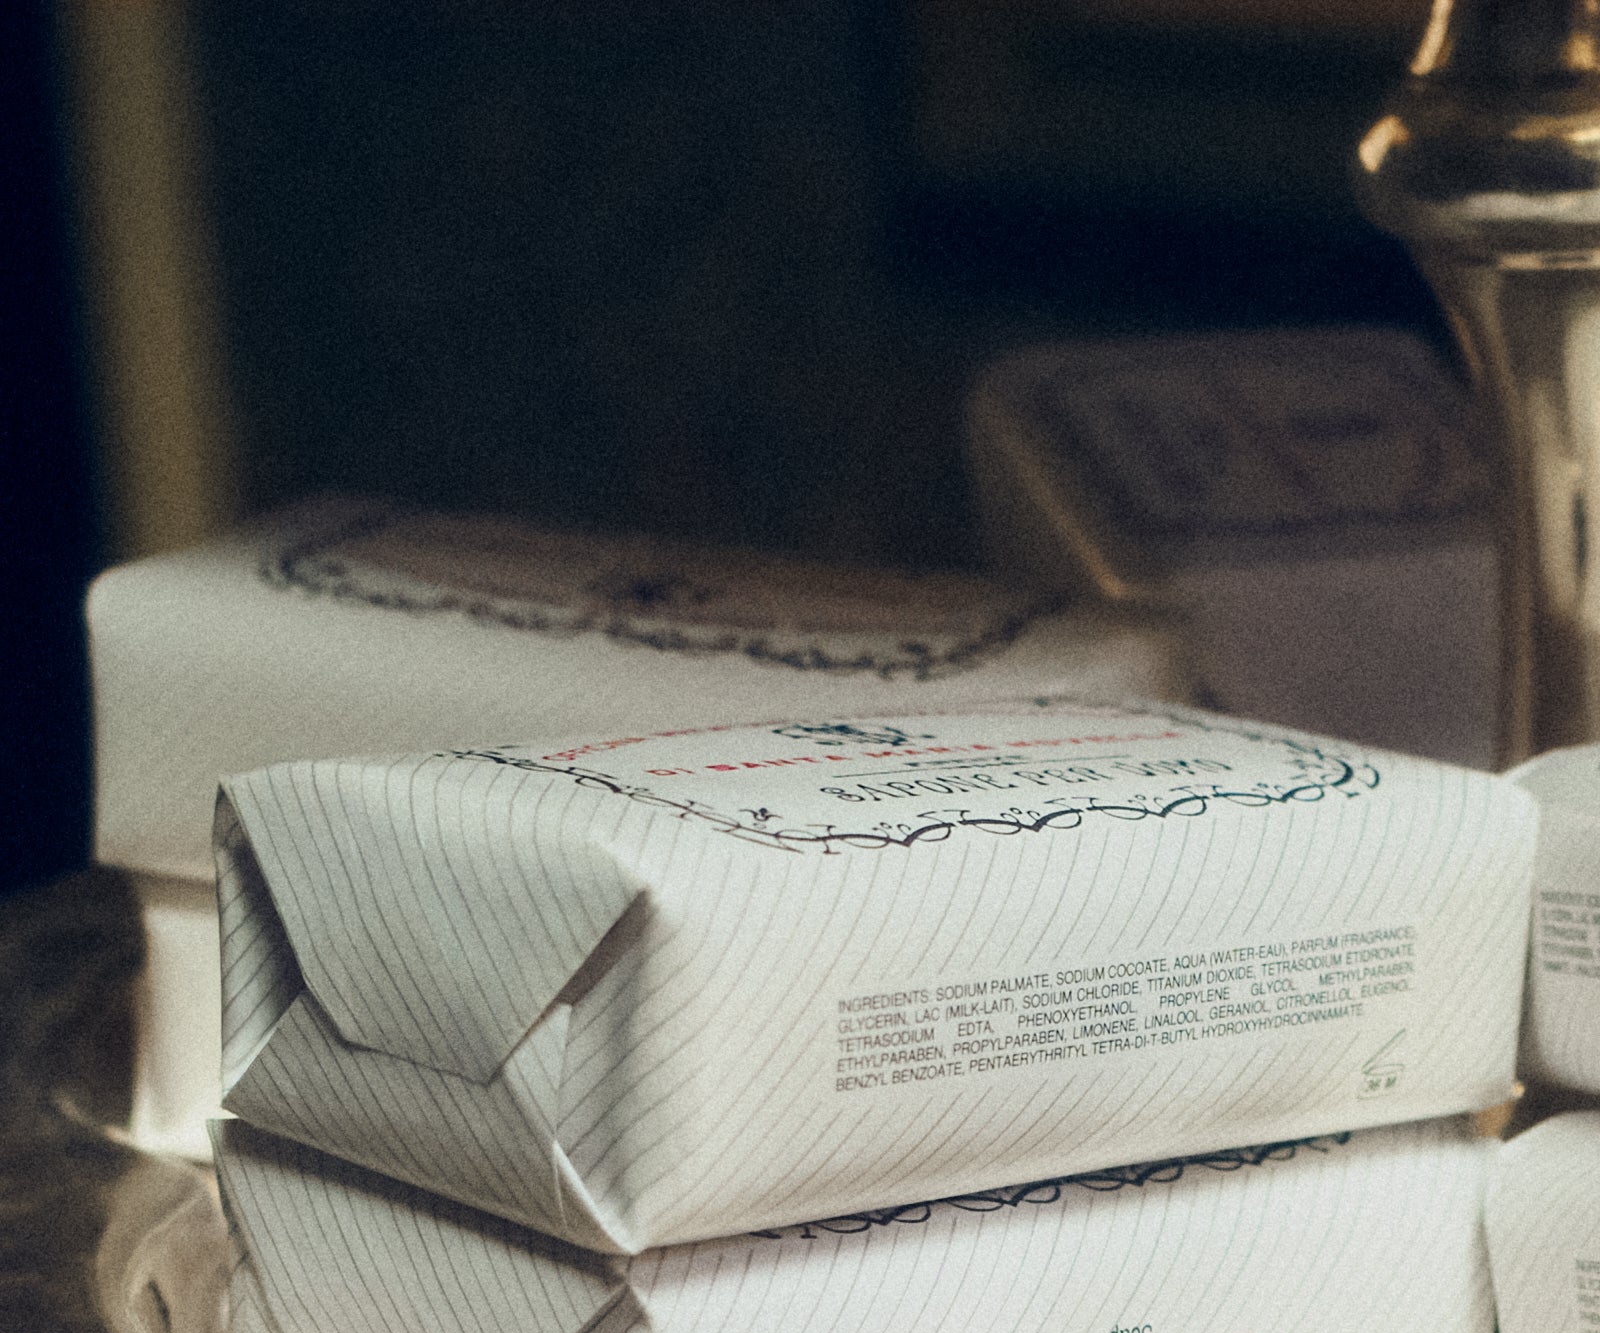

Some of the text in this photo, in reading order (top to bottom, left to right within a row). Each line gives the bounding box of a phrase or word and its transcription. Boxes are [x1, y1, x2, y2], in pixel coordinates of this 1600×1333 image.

[819, 773, 1019, 803] SAPONE
[915, 1006, 939, 1024] LAC
[1022, 988, 1072, 1009] SODIUM
[1076, 980, 1141, 1002] CHLORIDE,
[1147, 972, 1201, 992] TITANIUM
[1261, 953, 1341, 976] TETRASODIUM
[936, 981, 986, 1001] SODIUM
[1055, 965, 1104, 985] SODIUM
[1174, 952, 1206, 969] AQUA
[1291, 935, 1337, 953] PARFUM
[837, 1027, 934, 1053] TETRASODIUM
[1159, 986, 1230, 1008] PROPYLENE
[837, 1044, 946, 1073] ETHYLPARABEN,
[952, 1027, 1067, 1057] PROPYLPARABEN,
[836, 1070, 887, 1091] BENZYL
[969, 1042, 1087, 1073] PENTAERYTHRITYL
[1092, 1027, 1197, 1055] TETRA-DI-T-BUTYL
